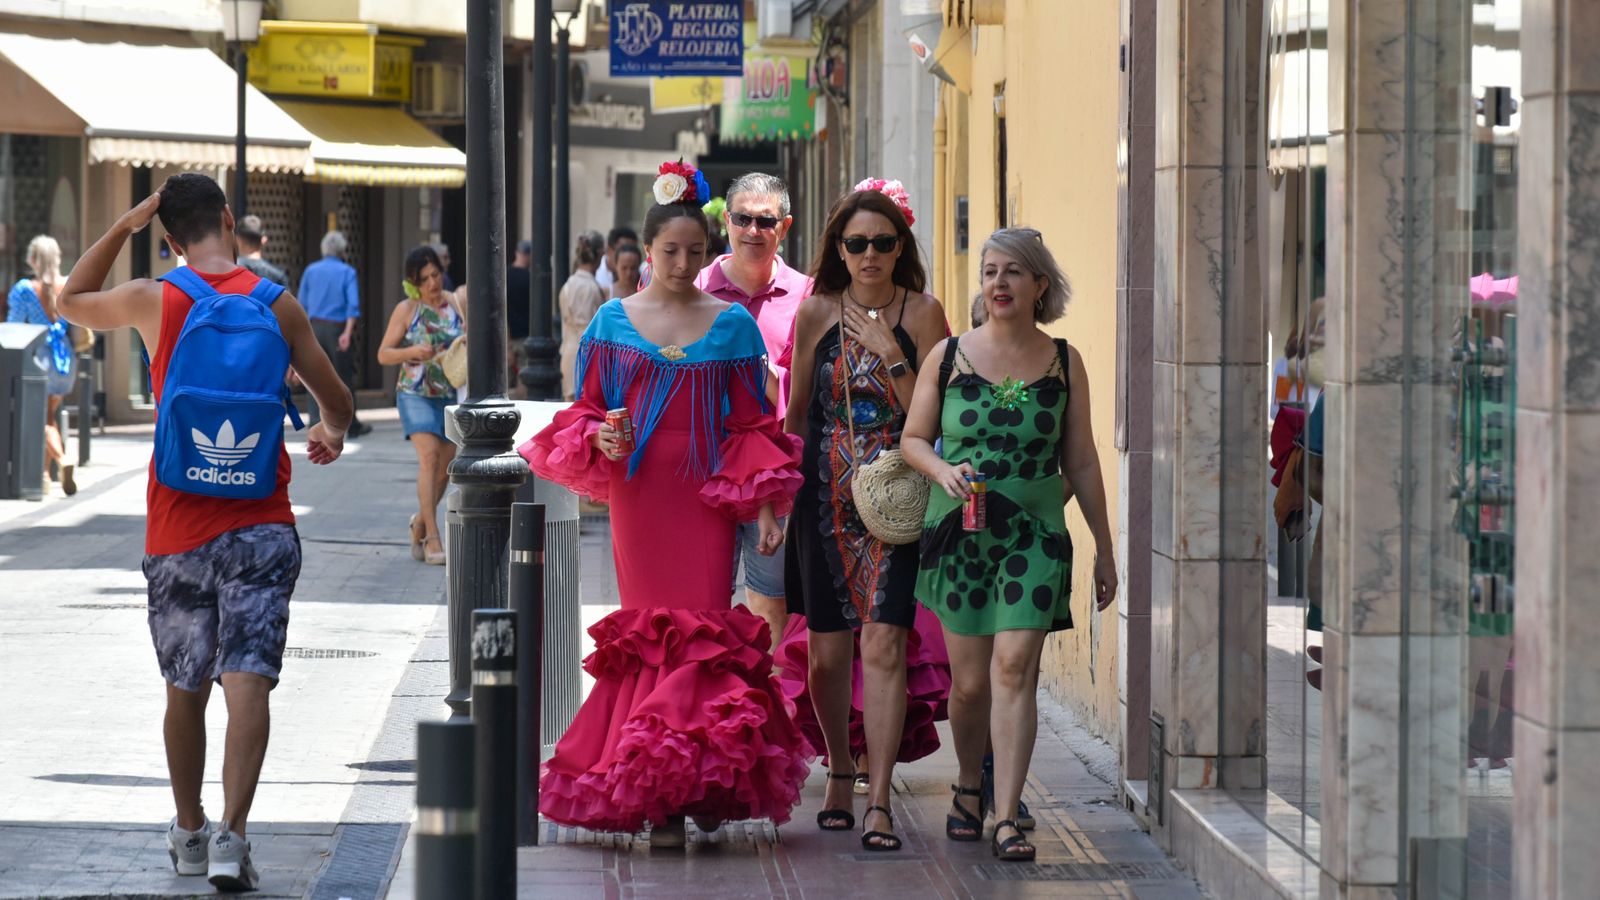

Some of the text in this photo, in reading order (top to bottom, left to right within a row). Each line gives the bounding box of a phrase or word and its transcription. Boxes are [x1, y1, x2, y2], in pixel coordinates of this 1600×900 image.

[668, 4, 740, 21] PLATERIA
[671, 22, 740, 39] REGALOS
[658, 40, 740, 57] RELOJERIA
[186, 466, 257, 485] adidas
